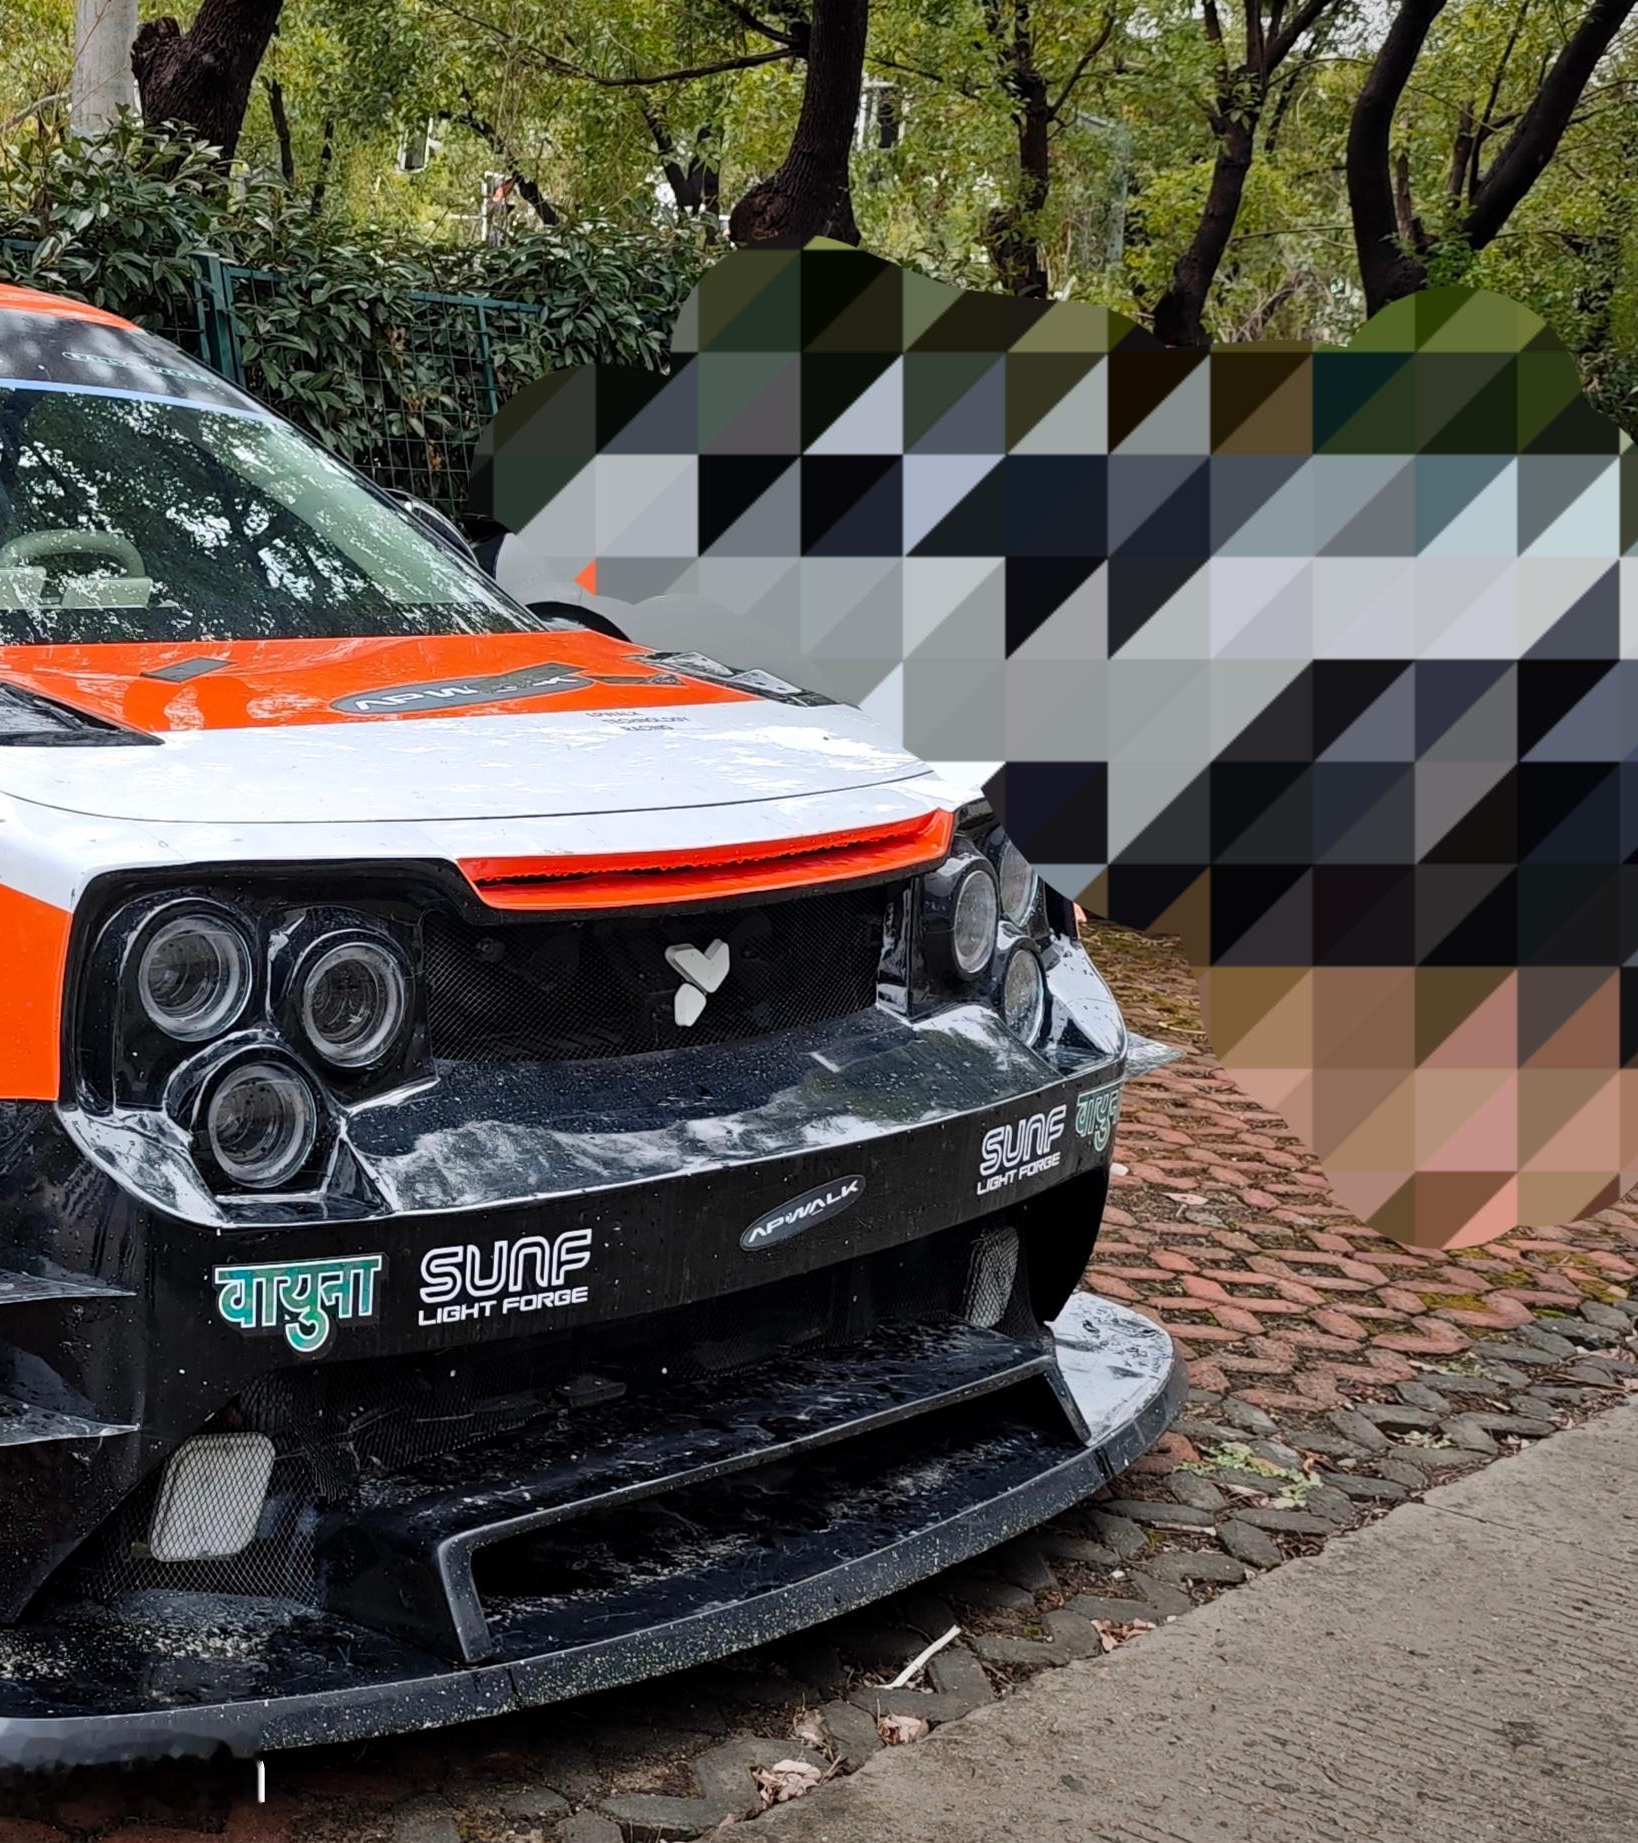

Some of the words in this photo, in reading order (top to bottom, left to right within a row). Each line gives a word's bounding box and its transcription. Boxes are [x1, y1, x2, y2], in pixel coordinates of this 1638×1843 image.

[976, 1169, 1018, 1196] LIGHT
[1018, 1151, 1061, 1181] FORGE
[979, 1104, 1067, 1177] SUNF
[748, 1178, 860, 1244] APWALK
[418, 1228, 593, 1304] SUNF
[214, 1254, 383, 1353] वायुना
[417, 1301, 493, 1327] LIGHT
[502, 1285, 590, 1315] FORGE
